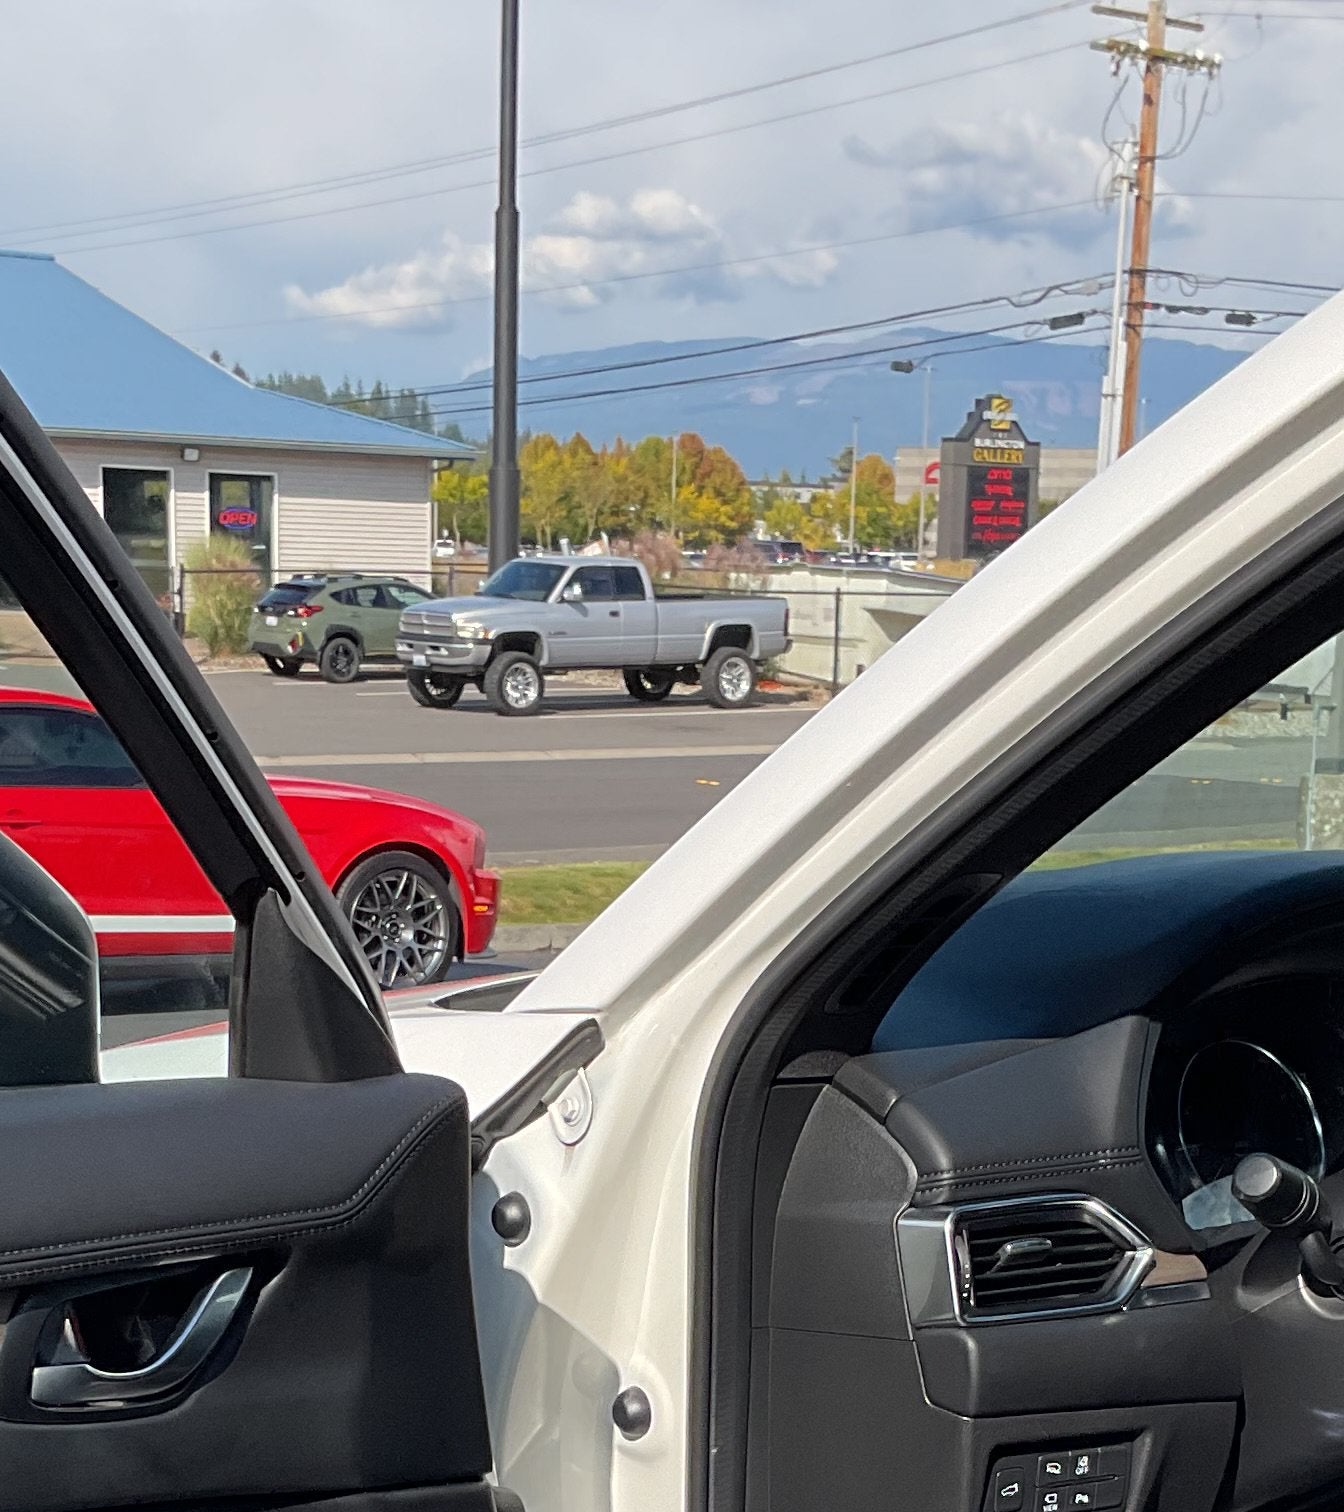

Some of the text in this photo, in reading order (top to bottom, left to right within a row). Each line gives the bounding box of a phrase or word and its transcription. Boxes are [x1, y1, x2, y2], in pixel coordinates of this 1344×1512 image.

[972, 447, 1025, 464] GALLERY
[218, 511, 258, 525] OPEN
[1075, 1466, 1089, 1475] OFF
